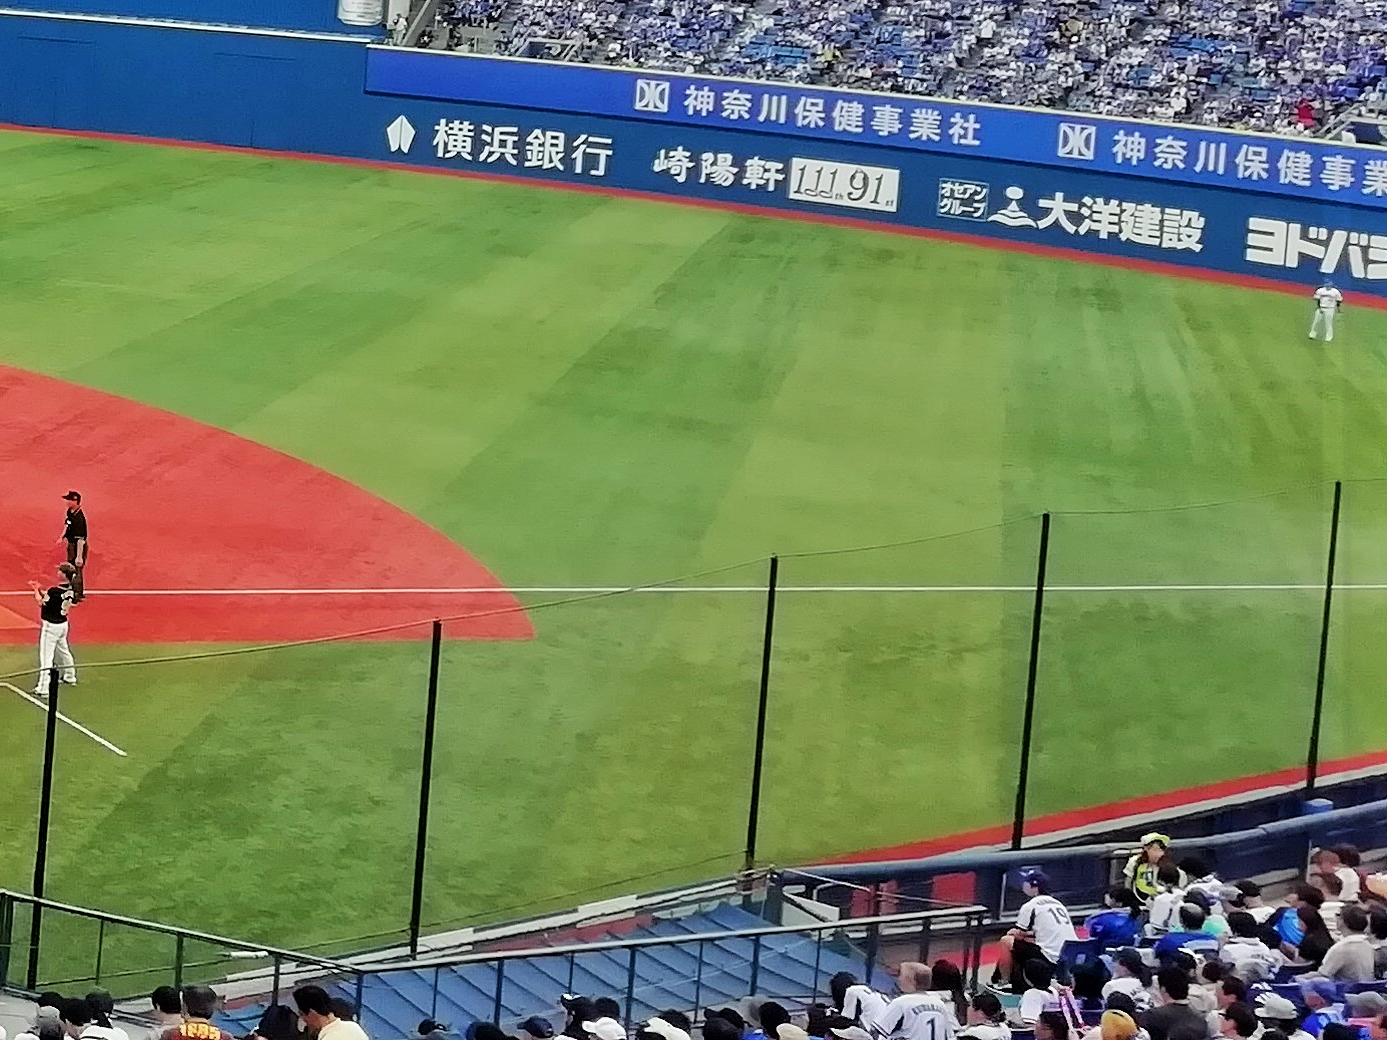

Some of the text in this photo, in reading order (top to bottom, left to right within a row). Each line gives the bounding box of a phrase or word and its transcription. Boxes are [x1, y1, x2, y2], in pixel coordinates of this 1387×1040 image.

[684, 84, 982, 147] 神奈川保健事業社
[432, 118, 614, 177] 横浜銀行
[653, 145, 784, 192] 崎陽軒
[939, 198, 986, 218] グループ
[941, 181, 987, 199] オセアン
[1037, 192, 1206, 253] 大洋建設
[1047, 906, 1071, 926] 19
